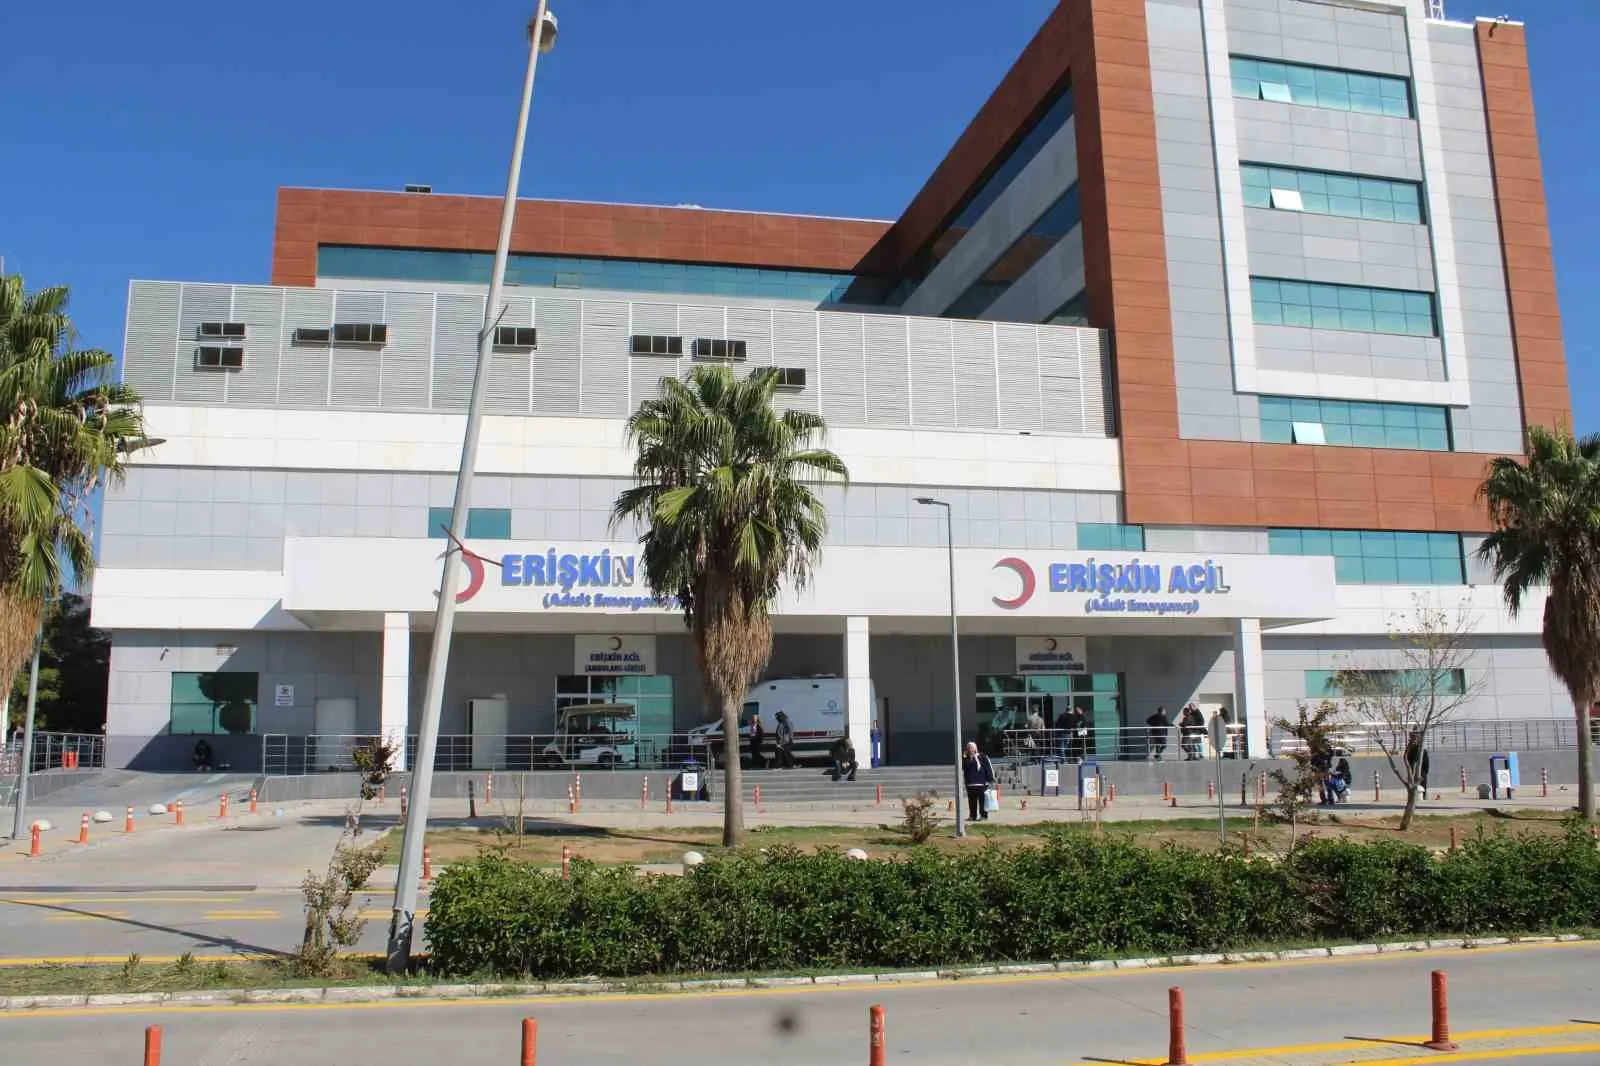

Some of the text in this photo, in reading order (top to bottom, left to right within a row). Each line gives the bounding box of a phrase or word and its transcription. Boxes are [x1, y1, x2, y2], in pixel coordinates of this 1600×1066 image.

[501, 547, 635, 593] ERİŞKİN
[1049, 557, 1231, 599] ERİŞKİN ACİL
